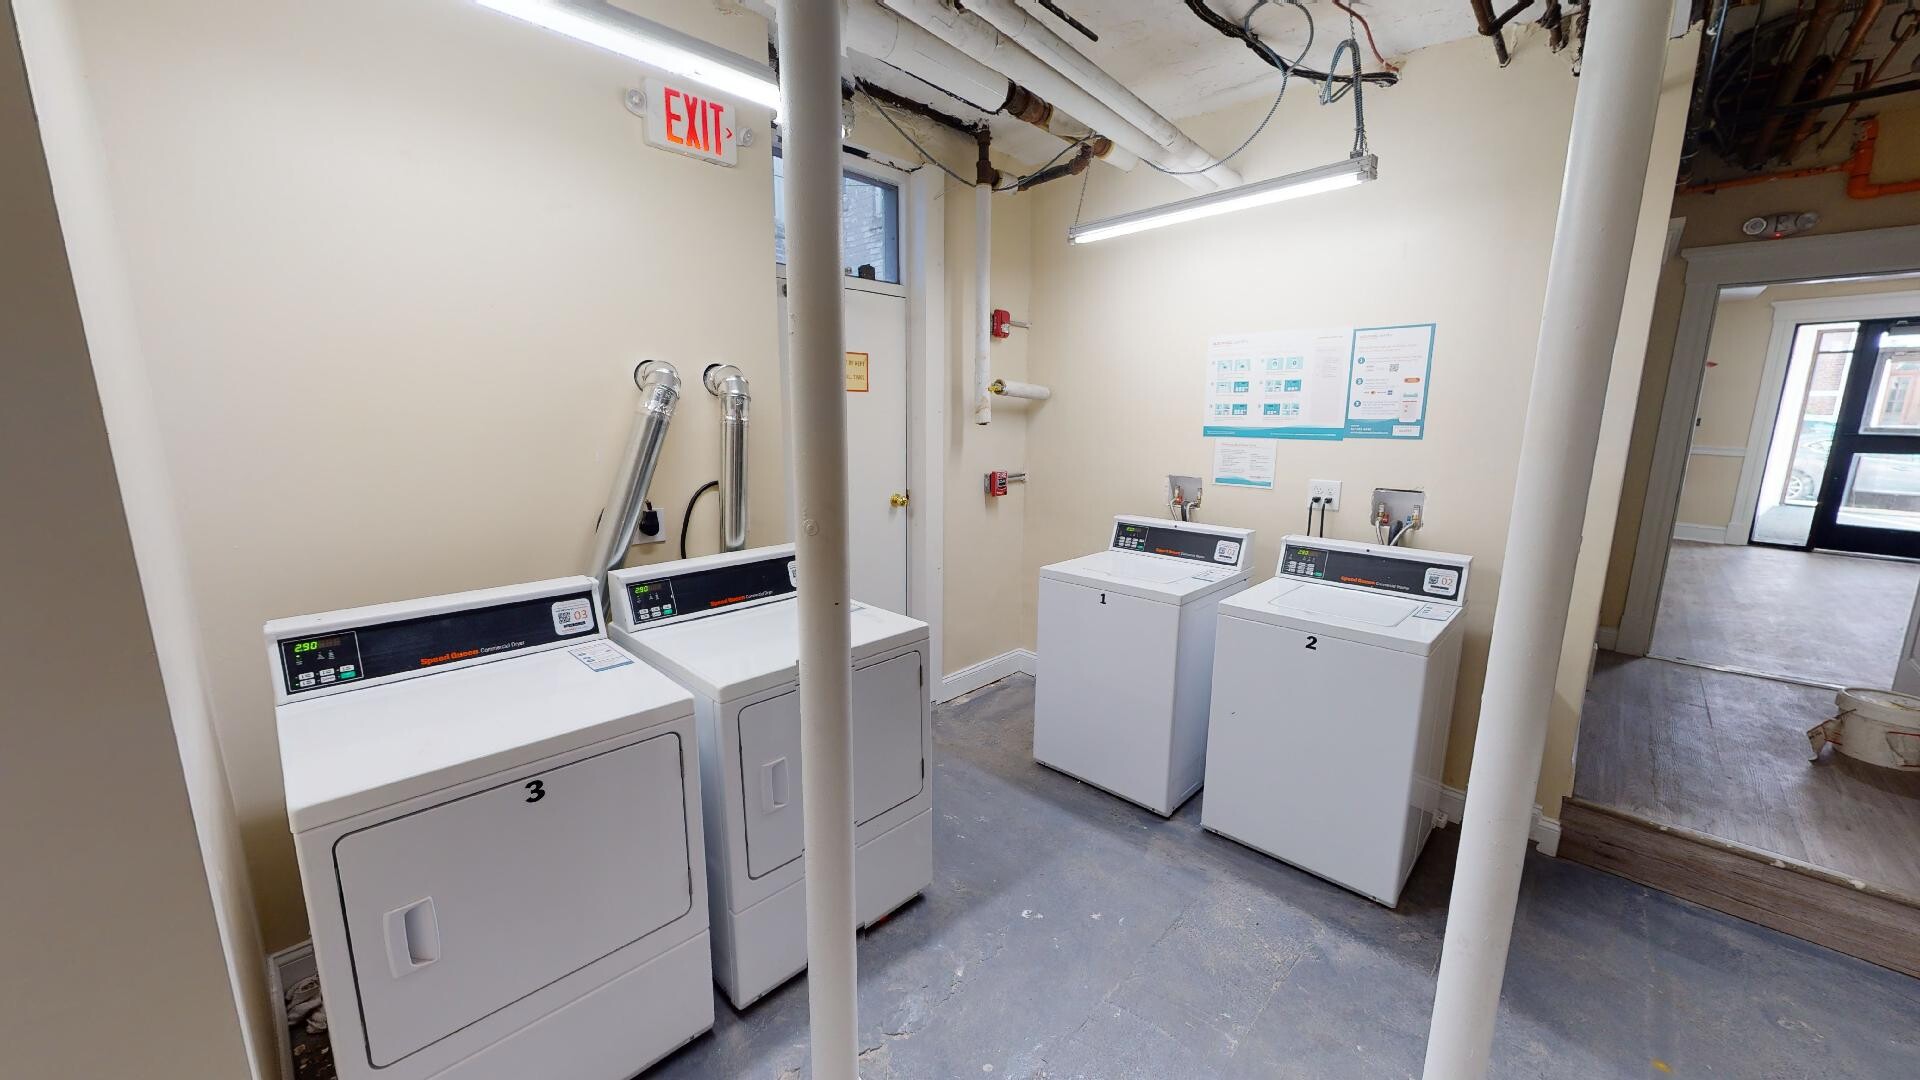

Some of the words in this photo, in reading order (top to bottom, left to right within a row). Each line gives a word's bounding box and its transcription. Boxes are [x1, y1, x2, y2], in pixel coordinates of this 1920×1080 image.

[664, 86, 724, 156] EXIT
[1441, 577, 1453, 586] 02
[1099, 593, 1106, 605] 1
[574, 609, 588, 621] 03
[1305, 636, 1318, 650] 2
[420, 653, 449, 665] Speed
[450, 649, 480, 659] Queen
[480, 642, 511, 653] Commercial
[511, 640, 525, 648] Dryer
[524, 780, 546, 803] 3
